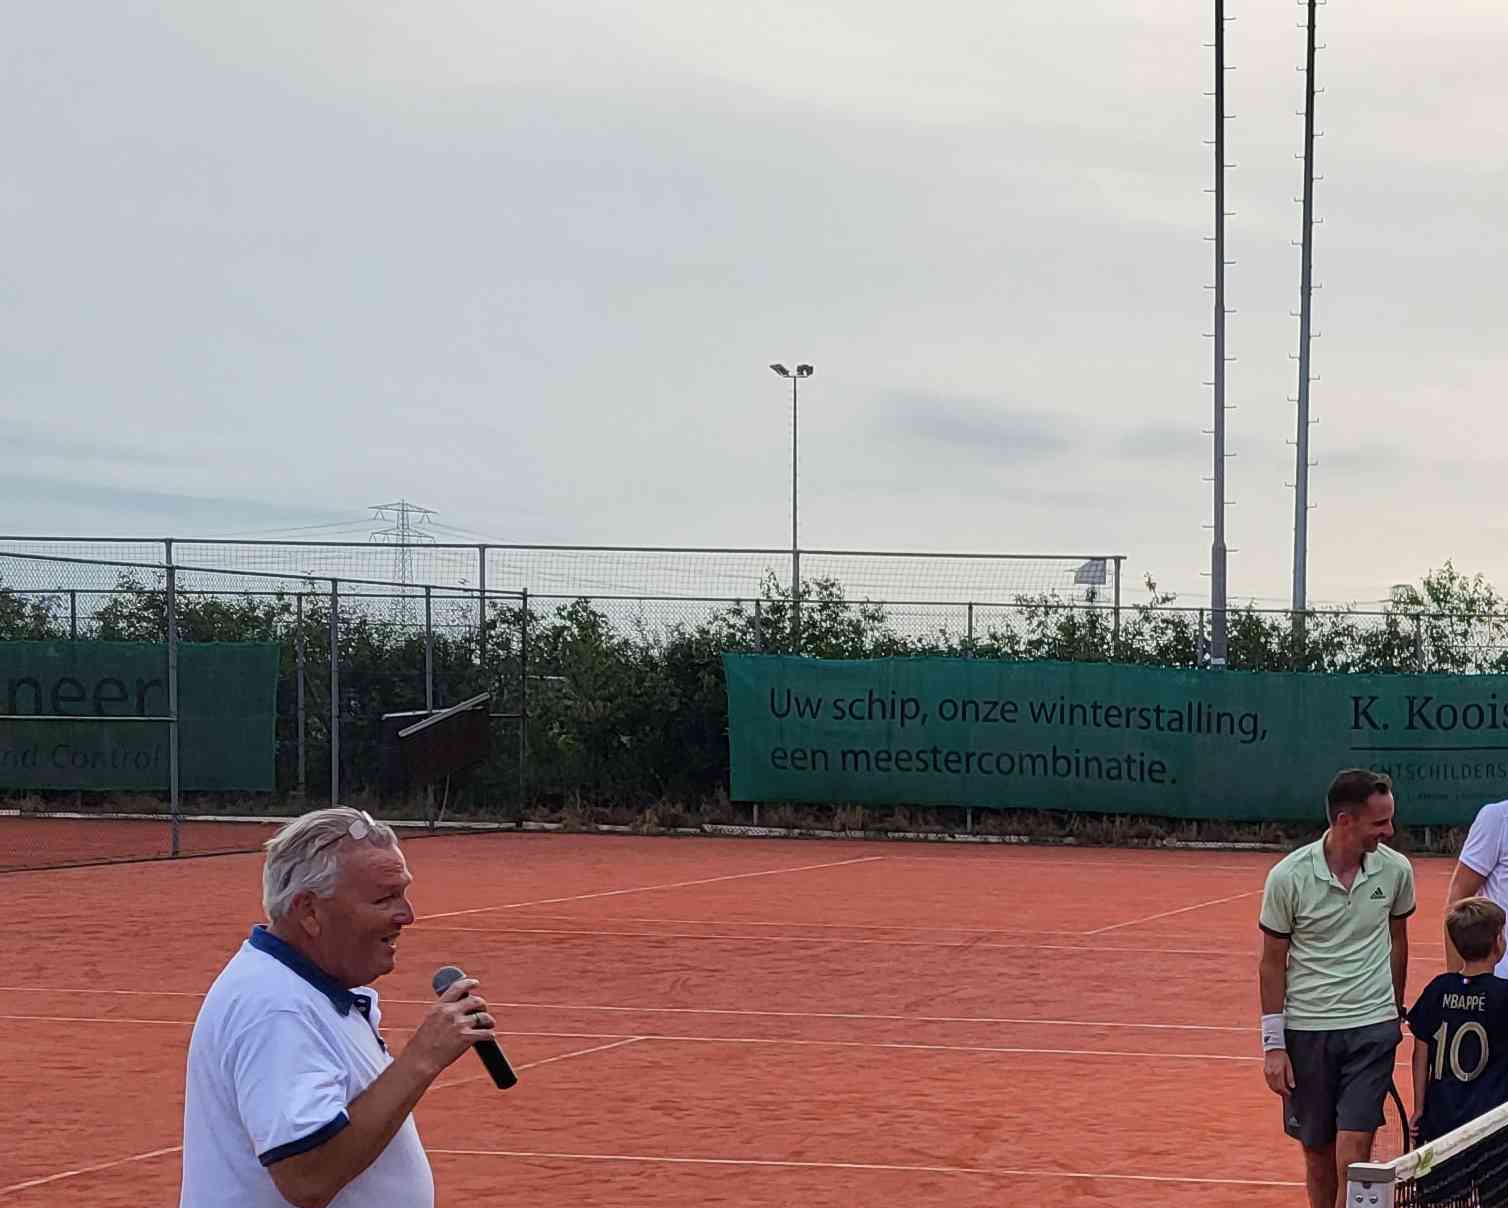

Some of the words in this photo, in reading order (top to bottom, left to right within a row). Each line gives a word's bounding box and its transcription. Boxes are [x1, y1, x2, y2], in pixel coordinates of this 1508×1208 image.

[769, 687, 823, 720] Uw
[831, 689, 929, 728] schip,
[938, 698, 1019, 724] onze
[1029, 695, 1269, 745] winterstalling,
[1350, 696, 1389, 731] K.
[770, 746, 830, 772] een
[840, 744, 1177, 786] meestercombinatie.
[1432, 1020, 1489, 1082] 10
